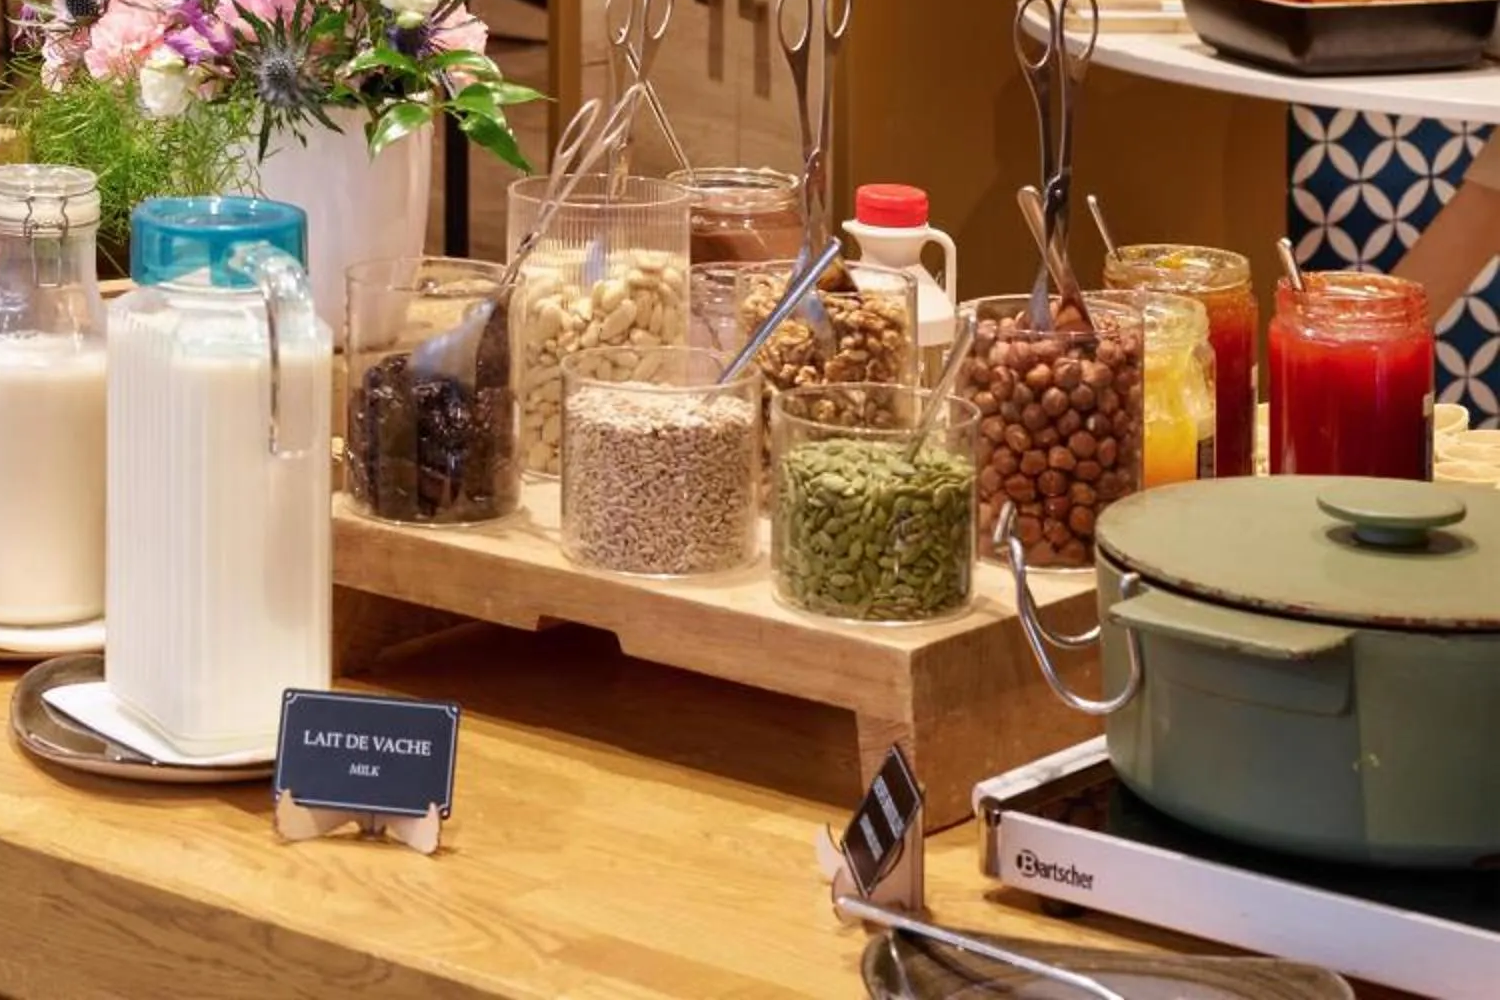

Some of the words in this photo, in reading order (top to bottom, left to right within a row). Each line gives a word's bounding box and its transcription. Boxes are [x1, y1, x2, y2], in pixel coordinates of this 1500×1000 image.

[303, 729, 343, 749] LAIT
[345, 733, 369, 751] DE
[372, 735, 432, 757] VACHE
[349, 762, 380, 777] MILK
[1016, 849, 1094, 891] Bartscher
